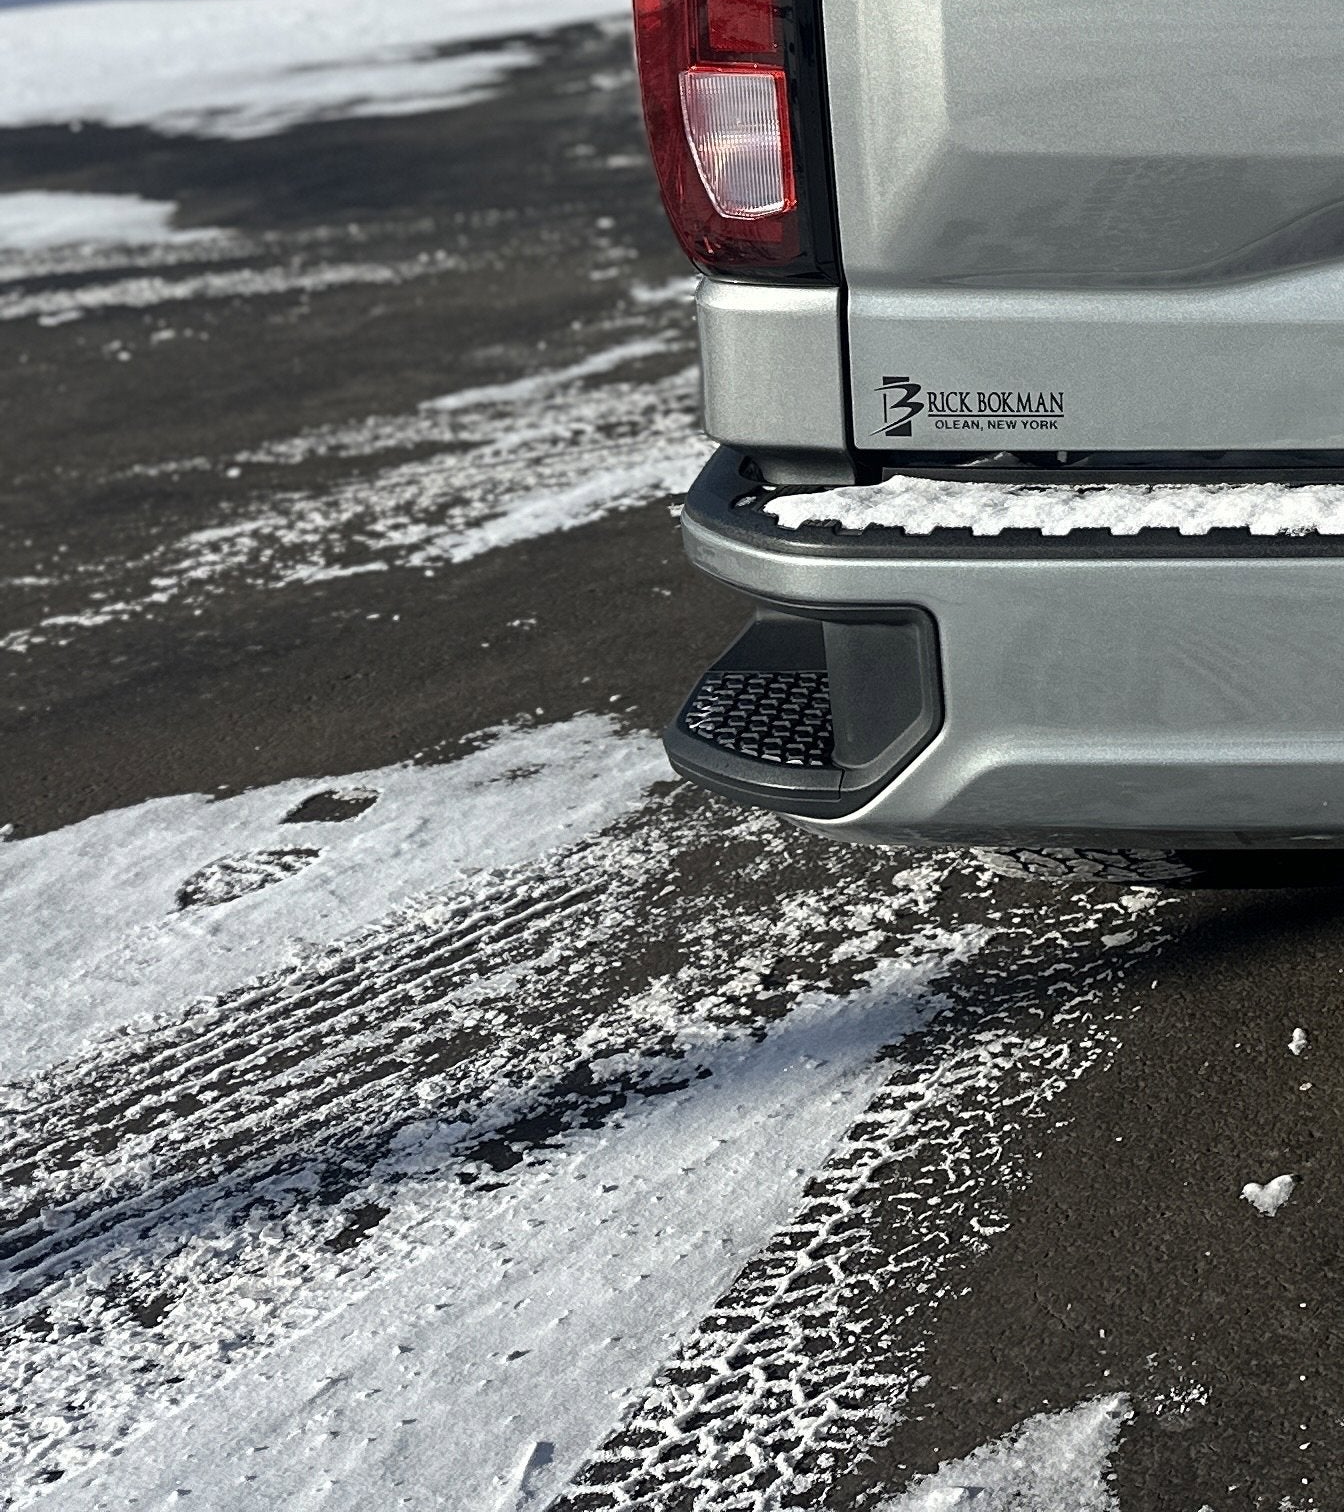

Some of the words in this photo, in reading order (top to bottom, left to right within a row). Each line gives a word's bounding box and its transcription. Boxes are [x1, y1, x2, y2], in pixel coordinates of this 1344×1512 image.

[927, 391, 973, 413] RICK
[977, 391, 1064, 413] BOKMAN
[935, 419, 984, 431] OLEAN,
[987, 419, 1017, 430] NEW
[1020, 419, 1058, 430] YORK
